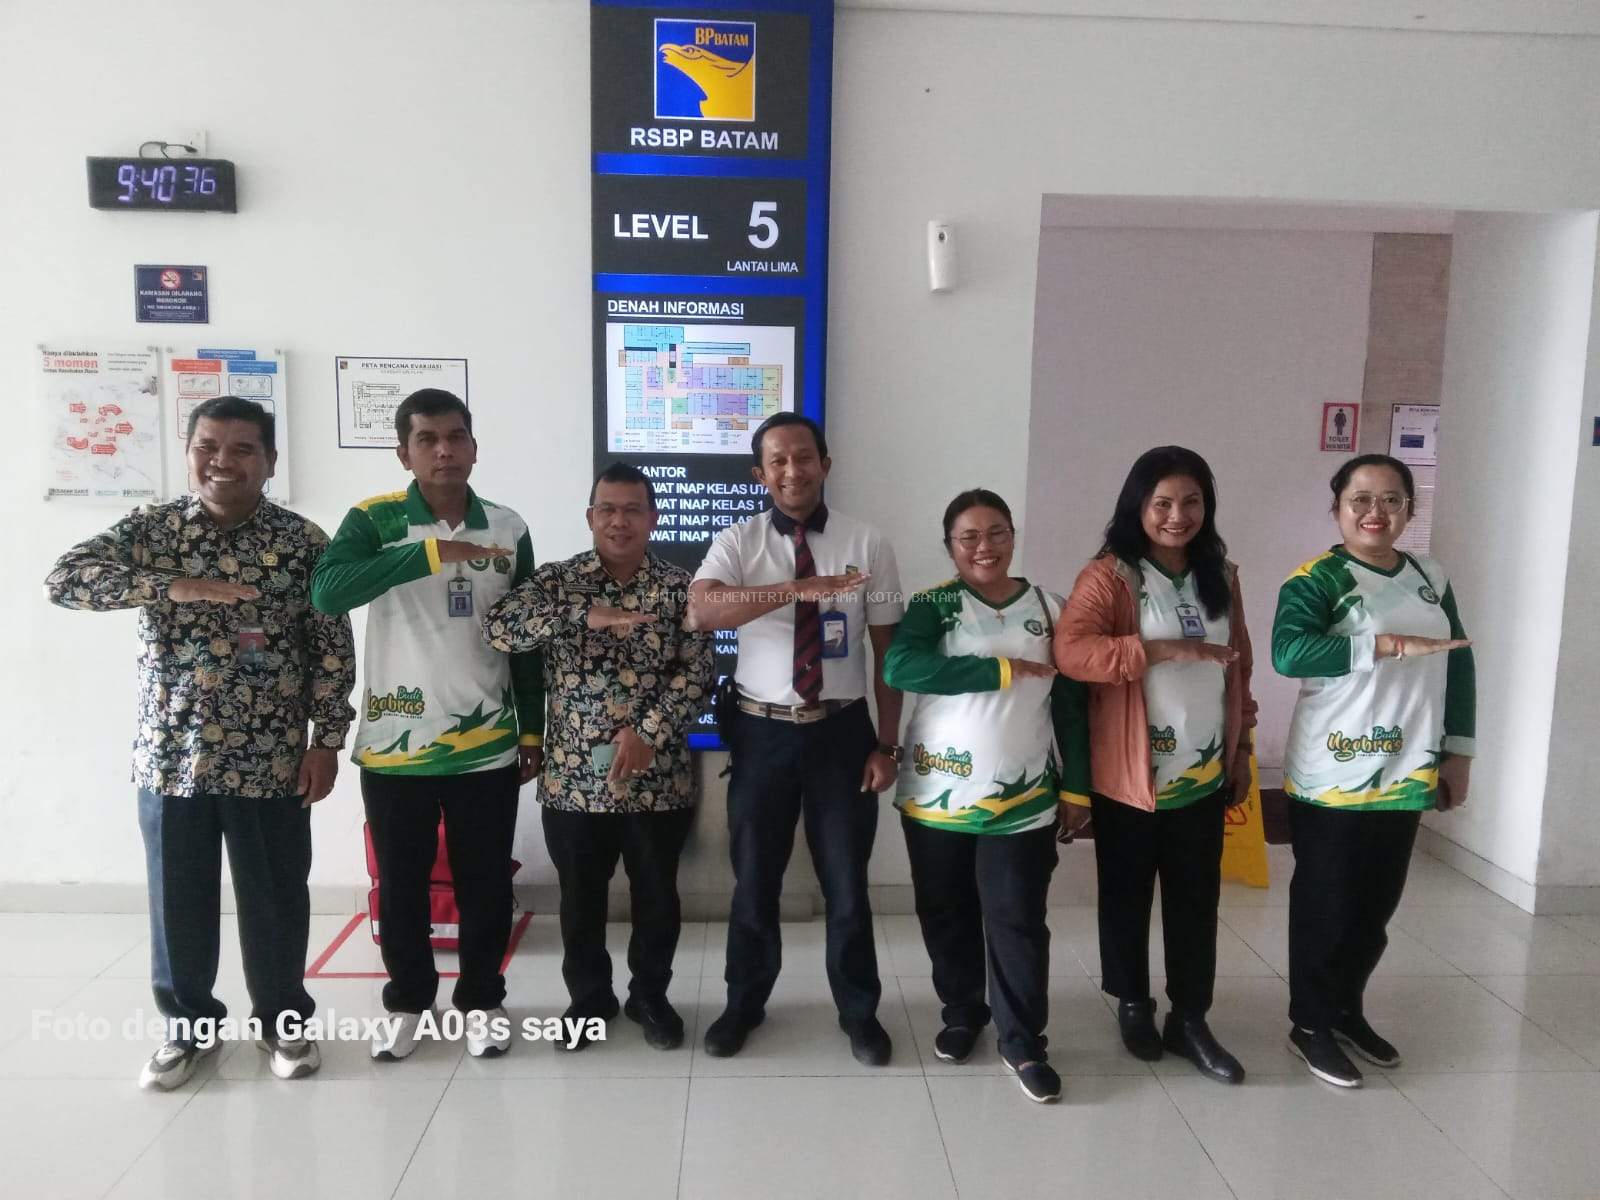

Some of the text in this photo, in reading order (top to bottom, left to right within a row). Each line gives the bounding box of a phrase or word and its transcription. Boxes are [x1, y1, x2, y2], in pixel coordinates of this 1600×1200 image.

[630, 127, 778, 150] RSBP BATAM
[117, 165, 177, 201] 9:40
[613, 201, 779, 249] LEVEL 5
[726, 260, 799, 273] LANTAI LIMA
[607, 299, 744, 316] DENAH INFORMASI
[636, 465, 687, 478] ANTOR
[676, 483, 706, 494] INAP
[706, 483, 748, 495] KELAS
[679, 499, 710, 510] INAP
[712, 499, 755, 511] KELAS
[757, 500, 764, 511] 1
[656, 514, 678, 526] AT
[679, 514, 710, 526] INAP
[648, 530, 678, 542] WAT
[679, 530, 710, 542] INAP
[714, 630, 738, 640] NTU
